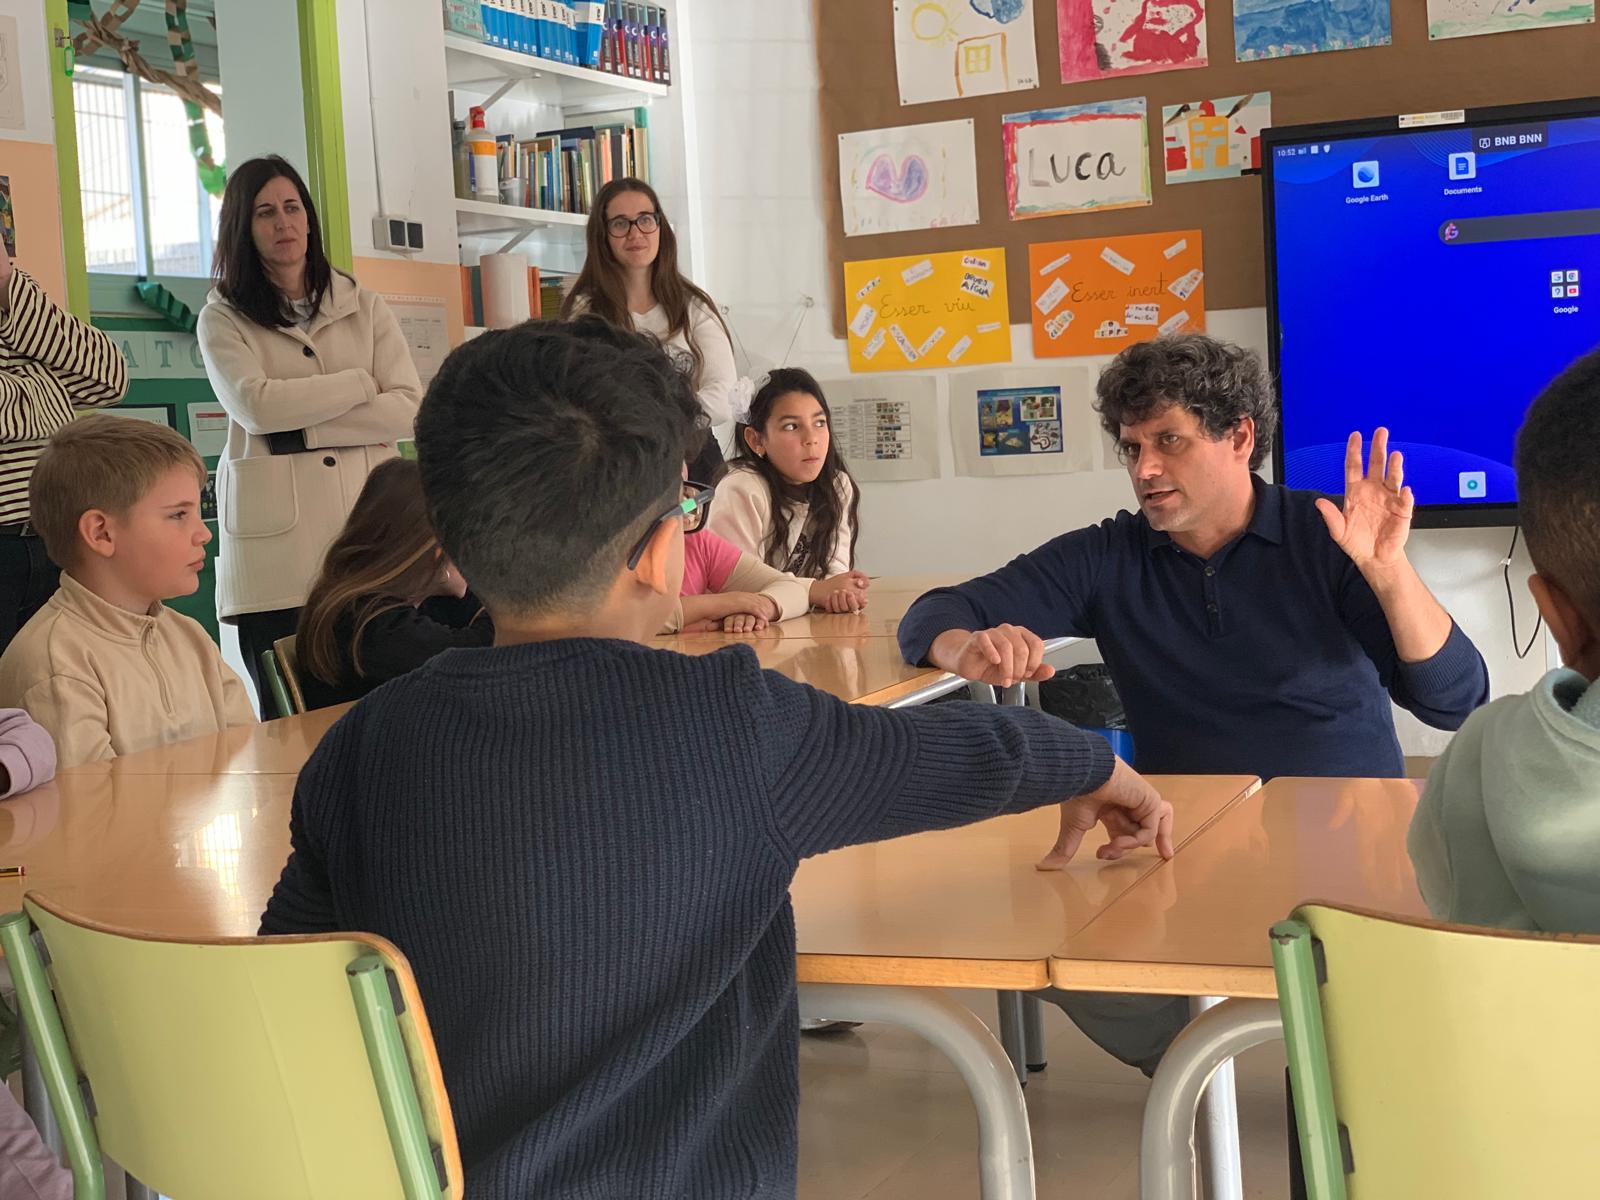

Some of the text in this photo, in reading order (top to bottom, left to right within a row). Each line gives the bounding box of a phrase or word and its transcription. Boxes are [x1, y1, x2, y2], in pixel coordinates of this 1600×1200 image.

[1494, 133, 1543, 147] BNB BNN
[1277, 149, 1296, 157] 10:52
[1028, 148, 1126, 188] Luca
[1443, 186, 1483, 196] Documents
[1345, 193, 1389, 205] Google Earth
[1071, 281, 1117, 303] Esser
[1126, 271, 1168, 297] inert
[880, 294, 976, 318] Esser viu
[1553, 305, 1579, 314] Google
